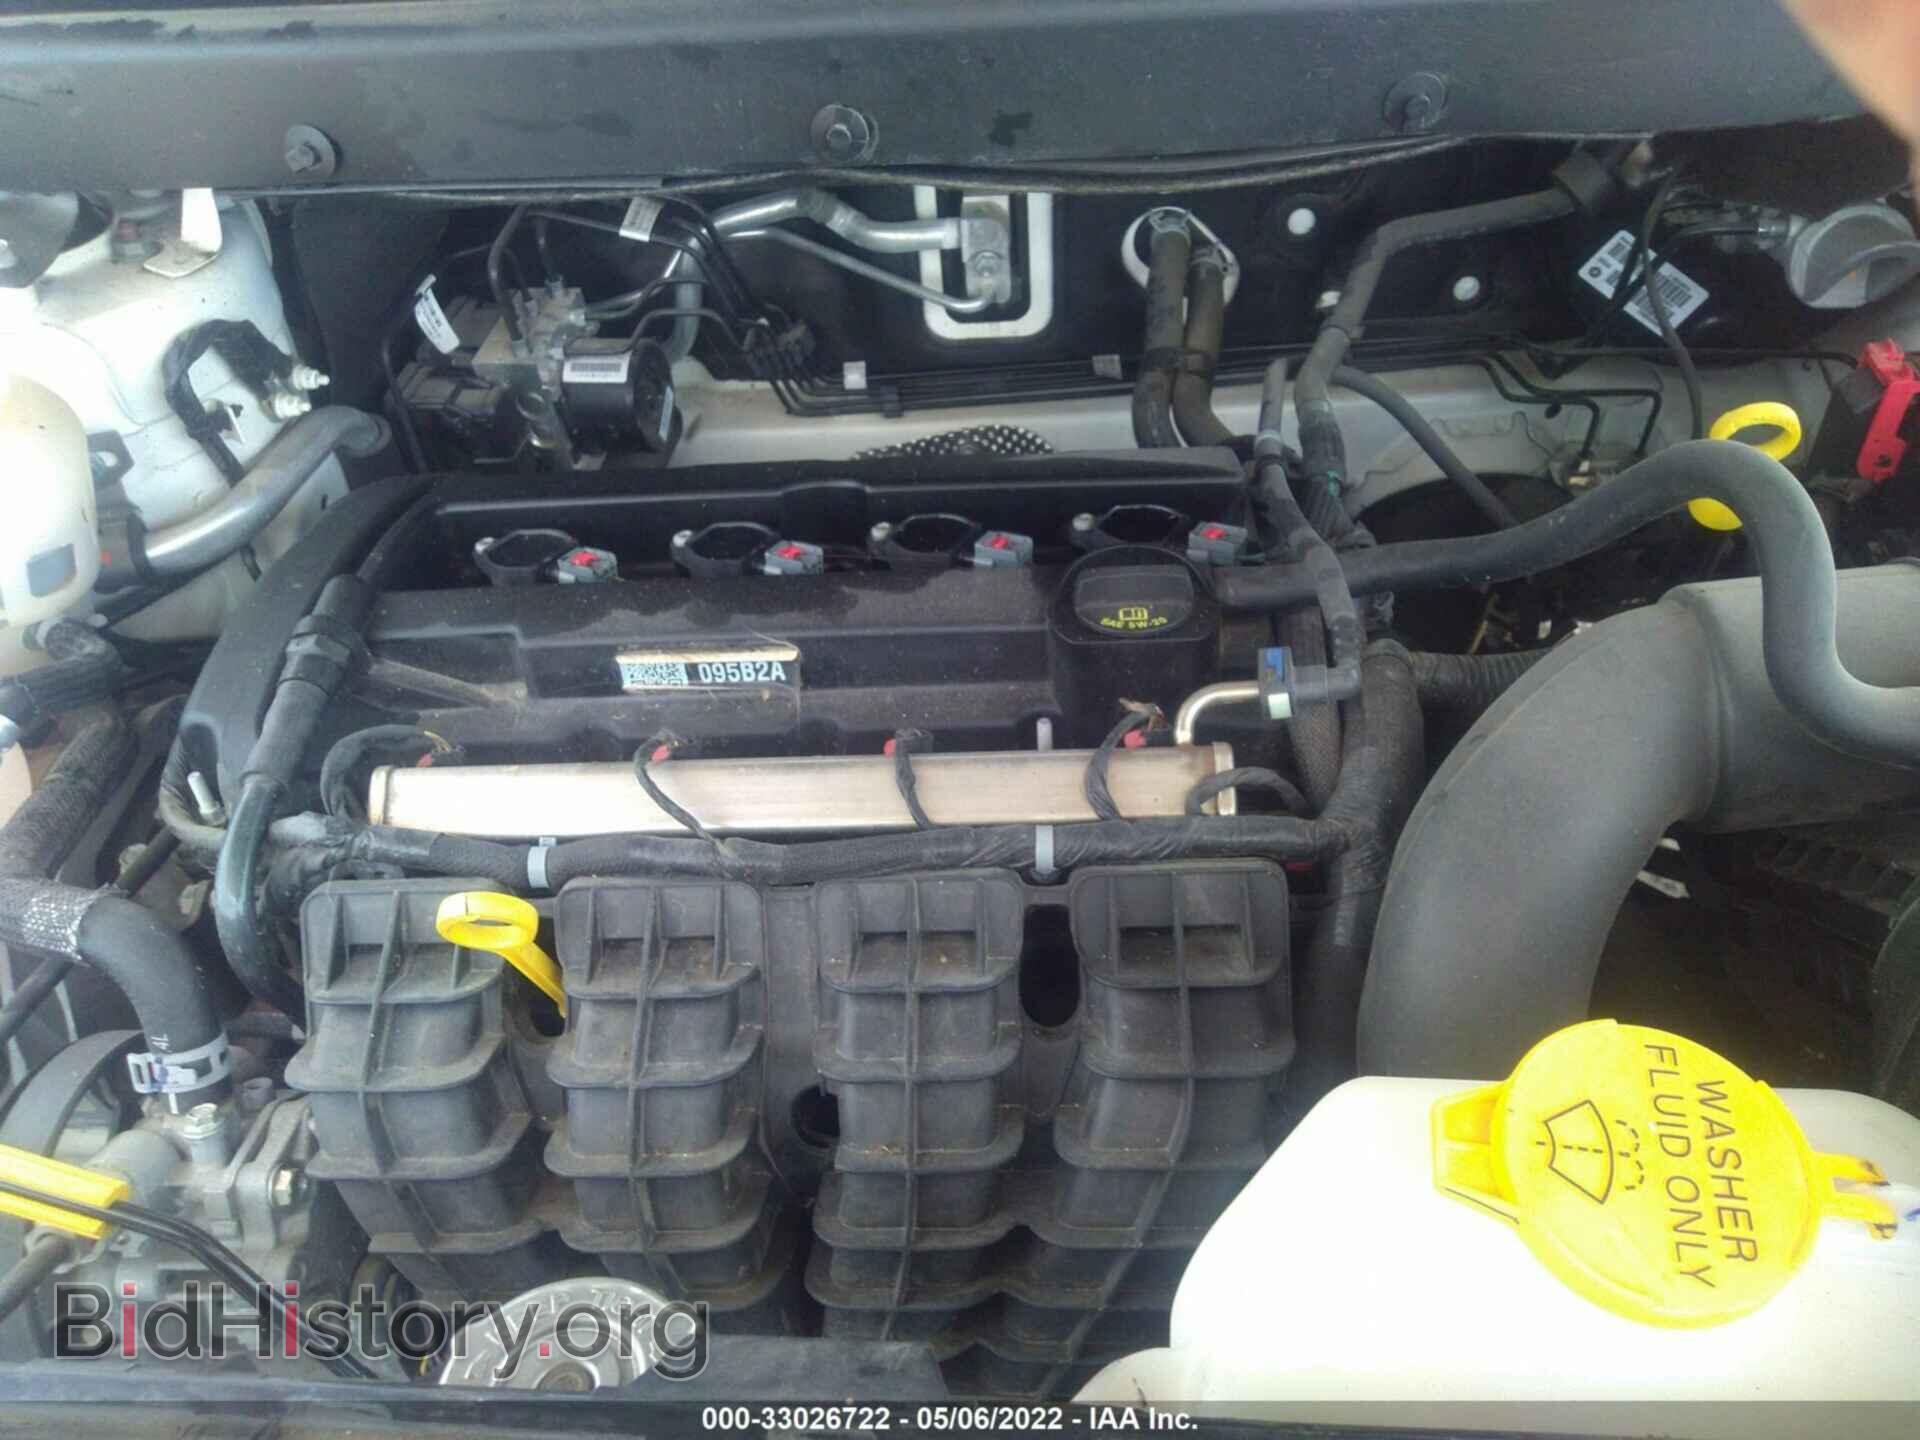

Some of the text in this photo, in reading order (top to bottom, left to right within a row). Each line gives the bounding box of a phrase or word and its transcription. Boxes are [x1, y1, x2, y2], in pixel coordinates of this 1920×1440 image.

[698, 661, 786, 684] 095B2A
[1644, 1043, 1717, 1289] FLUID ONLY
[1695, 1079, 1759, 1263] WASHER
